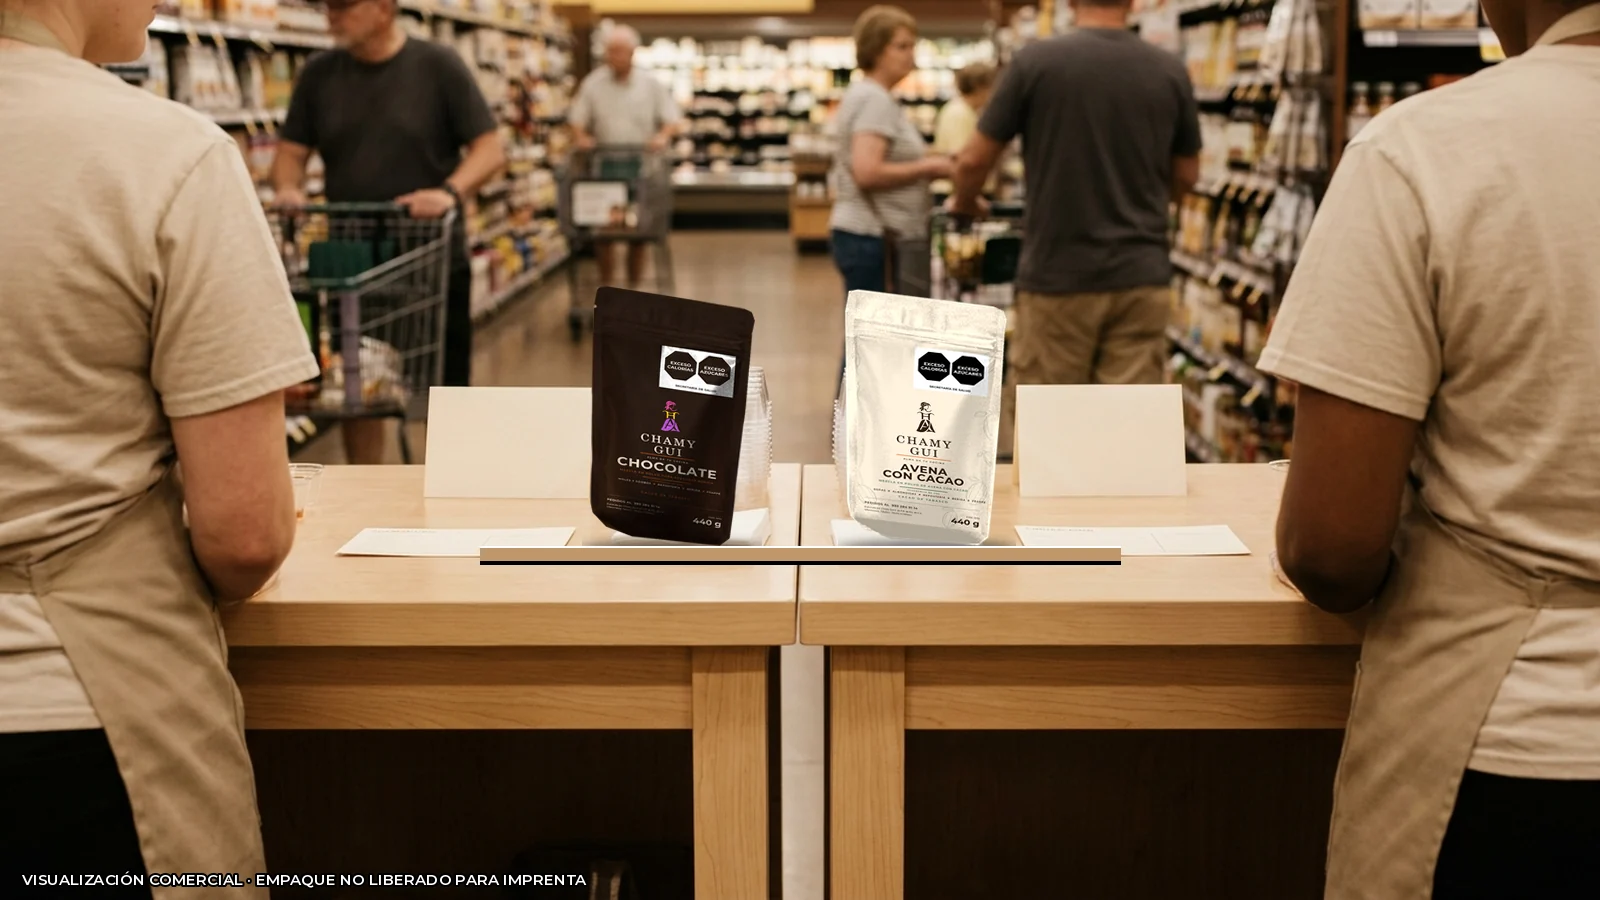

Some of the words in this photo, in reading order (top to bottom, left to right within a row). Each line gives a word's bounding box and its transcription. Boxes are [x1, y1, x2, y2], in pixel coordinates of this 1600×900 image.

[640, 433, 696, 449] CHAMY
[896, 435, 952, 449] CHAMY
[654, 446, 682, 457] GUI
[910, 447, 938, 457] GUI
[617, 456, 717, 480] CHOCOLATE
[900, 463, 948, 476] AVENA
[883, 469, 912, 480] CON
[917, 474, 964, 486] CACAO
[693, 518, 712, 526] 440
[951, 518, 970, 526] 440
